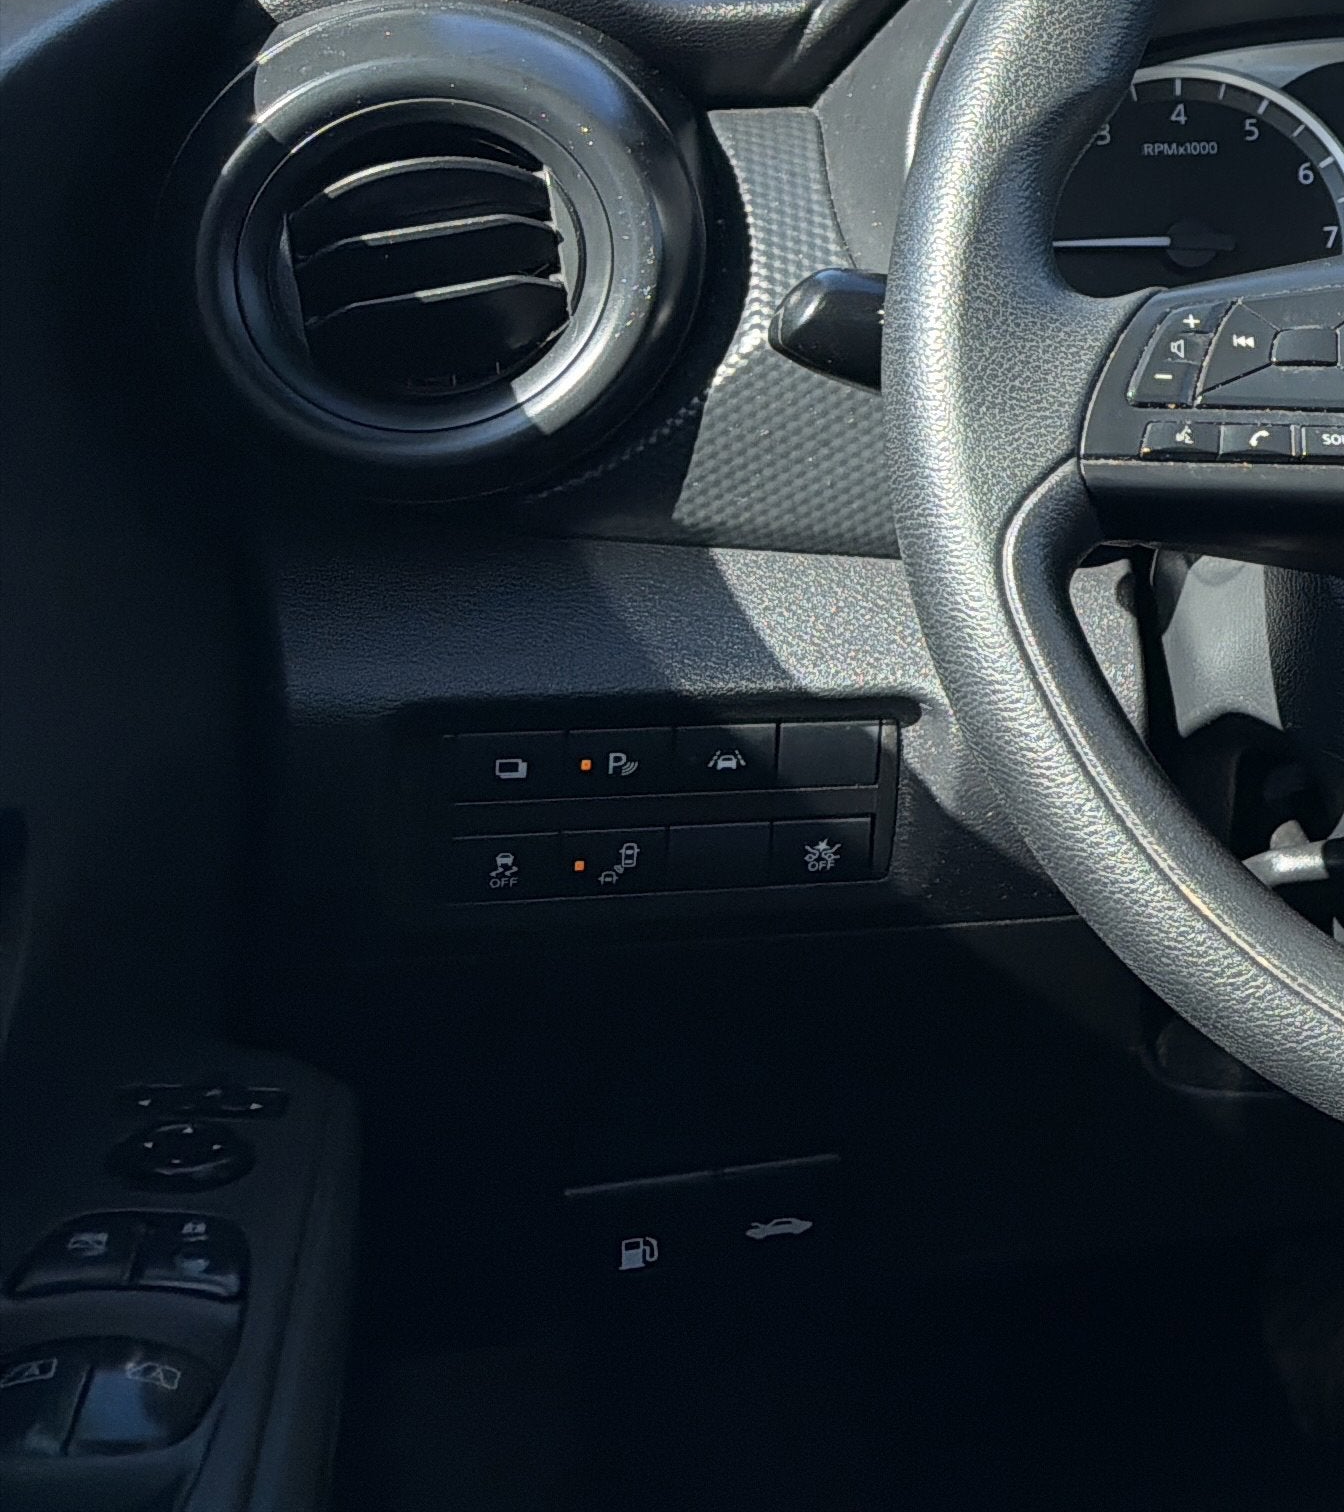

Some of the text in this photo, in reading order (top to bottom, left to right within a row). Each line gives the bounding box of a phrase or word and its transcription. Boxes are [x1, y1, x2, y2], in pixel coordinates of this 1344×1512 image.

[1170, 102, 1188, 126] 4
[1095, 122, 1112, 146] 3
[1244, 118, 1260, 141] 5
[1143, 140, 1219, 157] RPMx1000
[1297, 161, 1315, 185] 6
[1321, 225, 1339, 250] 7
[806, 858, 836, 873] OFF
[488, 875, 519, 889] OFF
